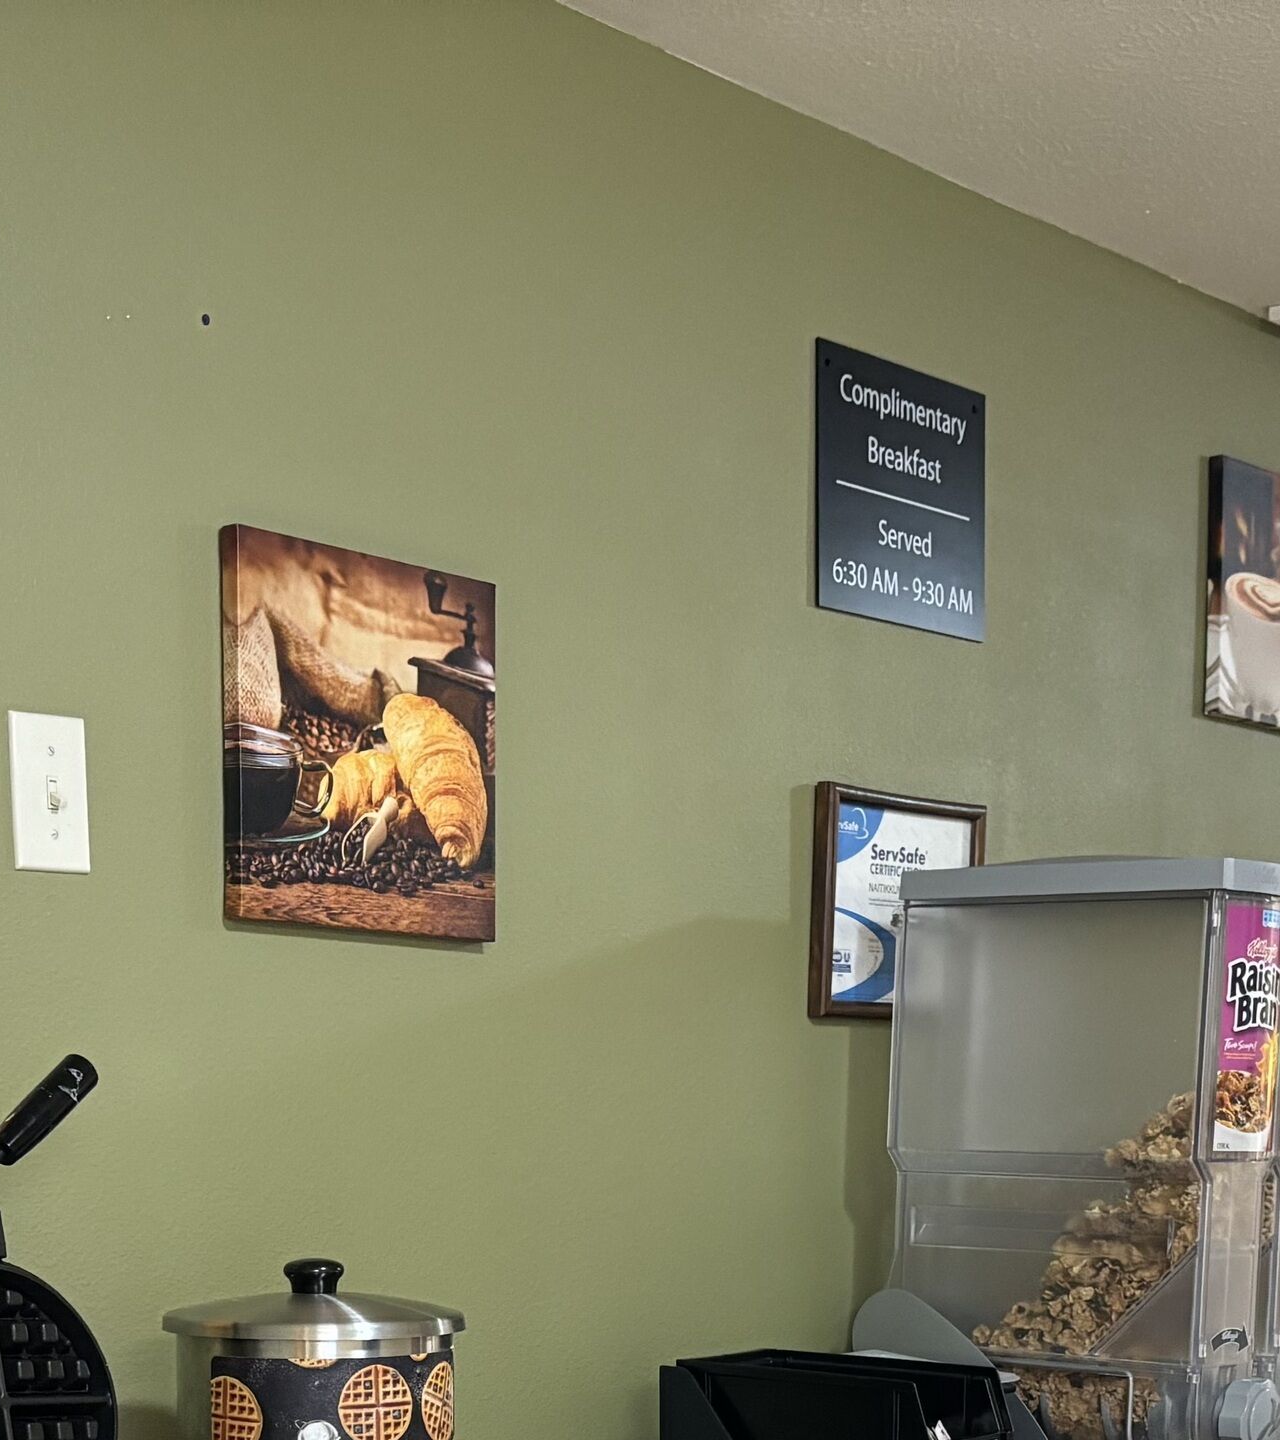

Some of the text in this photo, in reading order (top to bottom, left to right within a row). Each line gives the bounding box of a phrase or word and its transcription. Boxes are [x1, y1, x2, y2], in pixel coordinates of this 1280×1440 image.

[840, 374, 966, 445] Complimentary
[868, 436, 942, 483] Breakfast
[878, 520, 932, 557] Served
[832, 558, 867, 589] 6:30
[872, 566, 898, 596] AM
[912, 578, 944, 608] 9:30
[948, 586, 973, 615] AM
[871, 844, 926, 865] ServSafe
[1237, 995, 1276, 1027] Bran
